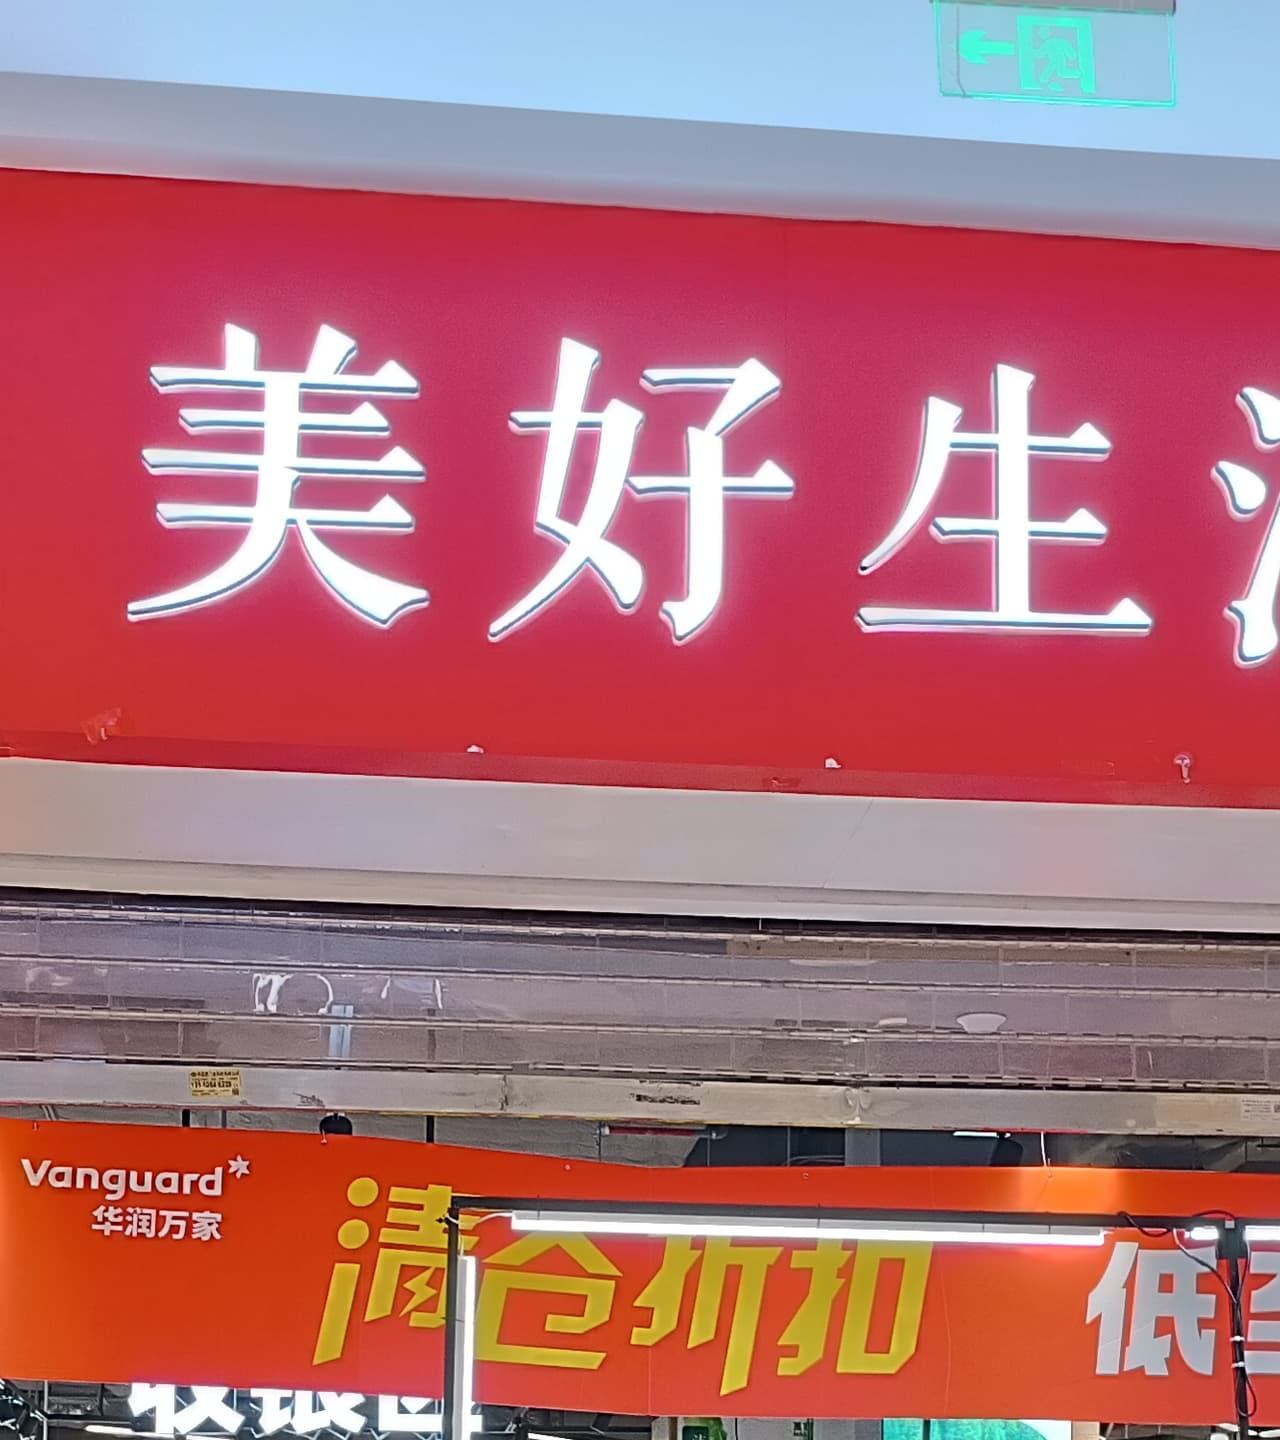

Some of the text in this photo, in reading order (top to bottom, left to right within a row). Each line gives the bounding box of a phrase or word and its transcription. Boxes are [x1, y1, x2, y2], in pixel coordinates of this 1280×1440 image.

[20, 1158, 224, 1201] Vanguard
[91, 1204, 223, 1241] 华润万家
[312, 1176, 934, 1397] 清仓折扣
